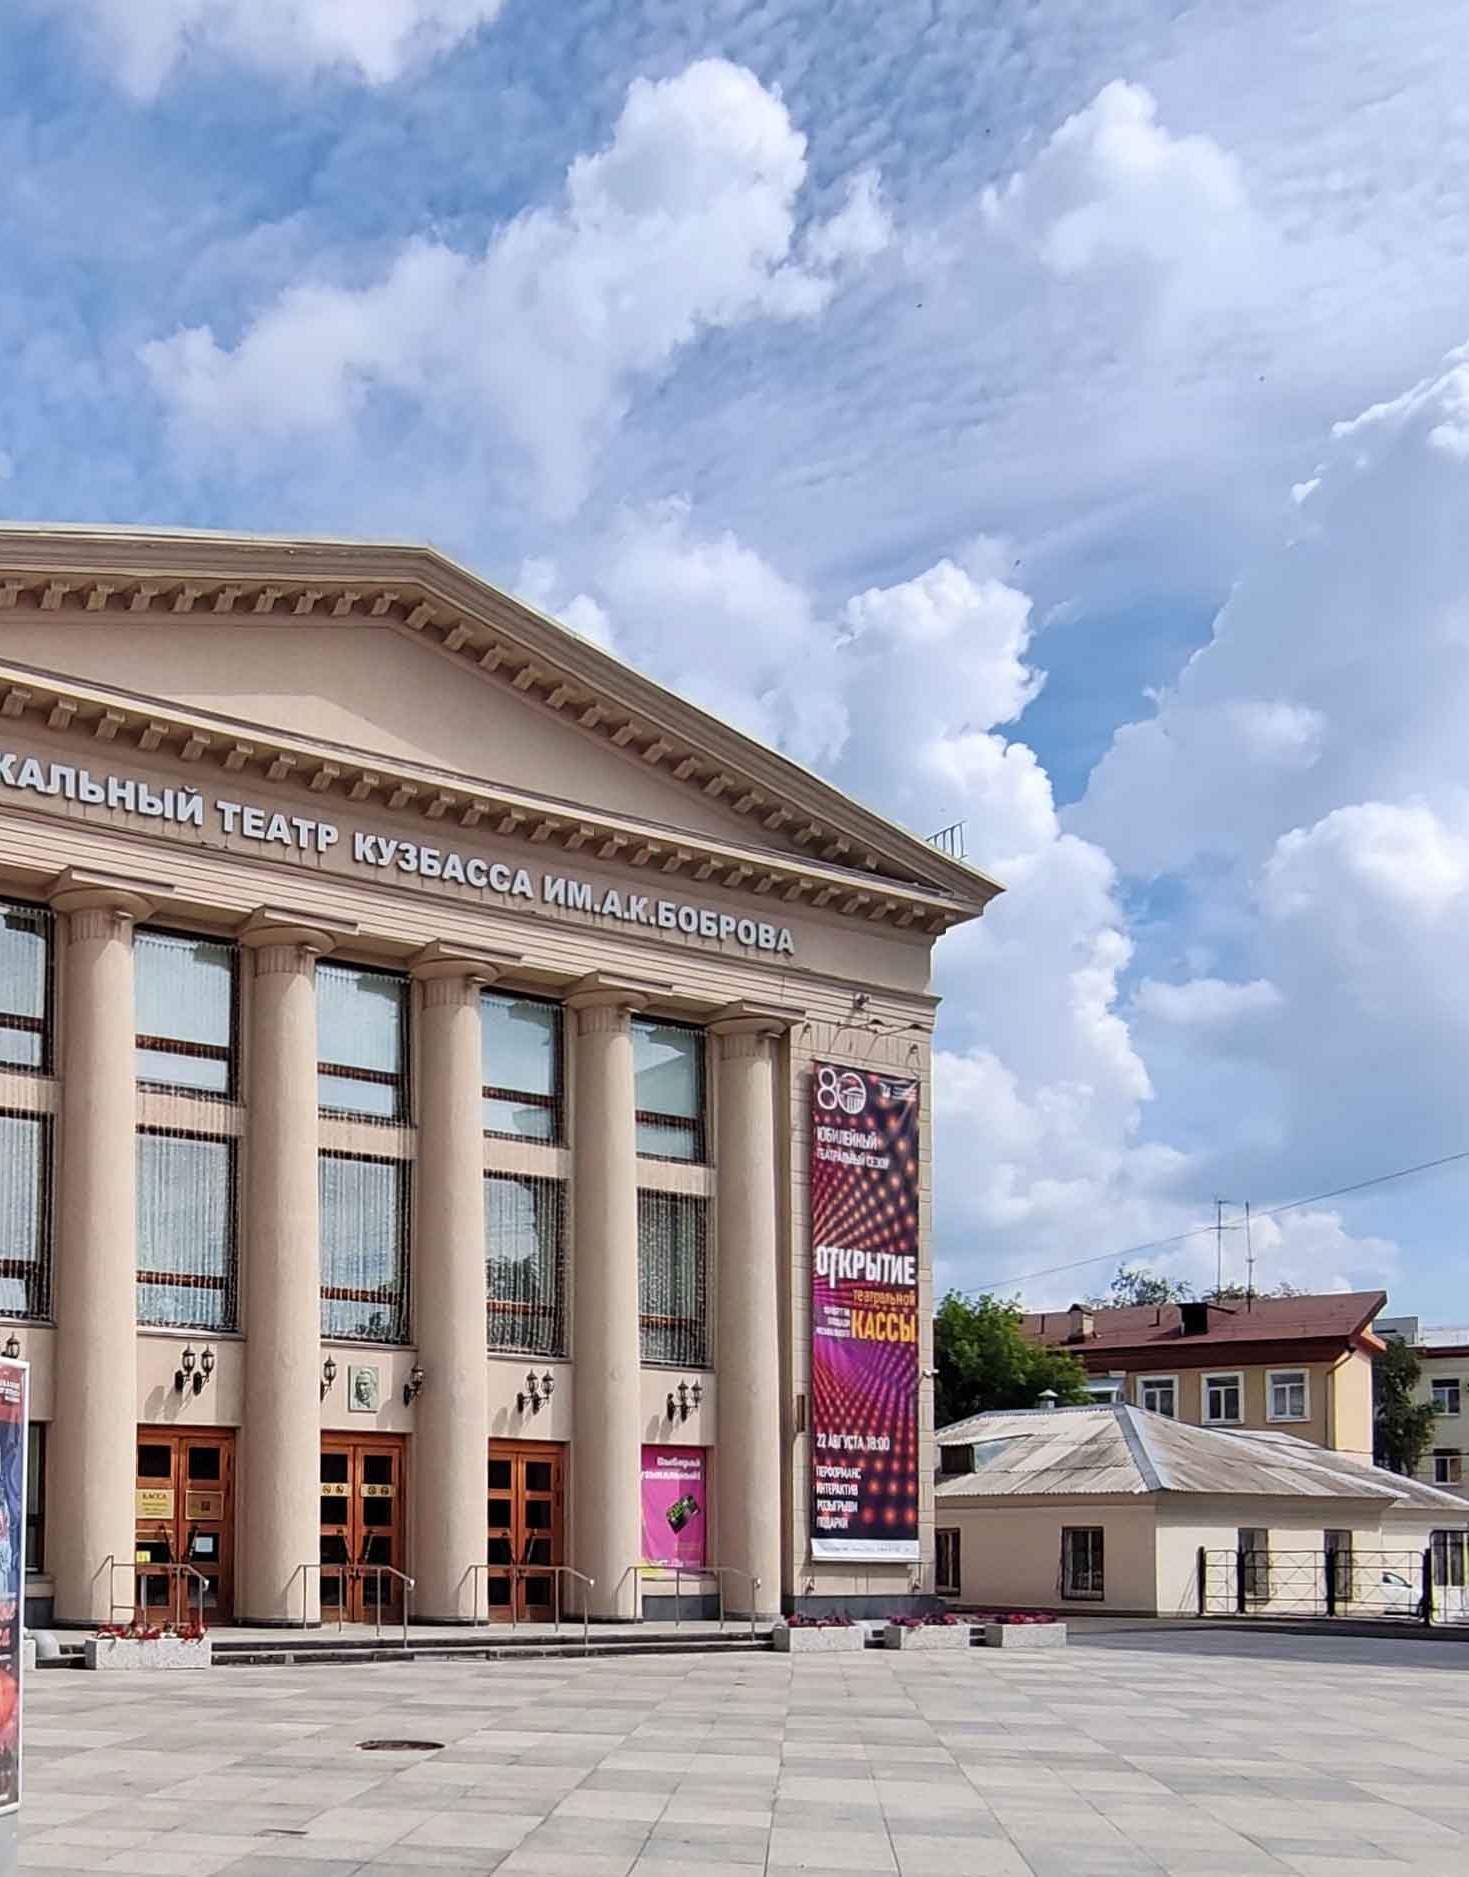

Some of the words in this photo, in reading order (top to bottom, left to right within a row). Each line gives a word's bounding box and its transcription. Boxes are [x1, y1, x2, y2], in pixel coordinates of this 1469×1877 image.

[216, 801, 339, 852] ТЕАТР
[354, 831, 534, 898] КУЗБАССА
[816, 1246, 915, 1288] ОТКРЫТИЕ
[852, 1289, 915, 1307] театральной
[851, 1309, 915, 1342] КАССЫ
[816, 1433, 825, 1448] 22
